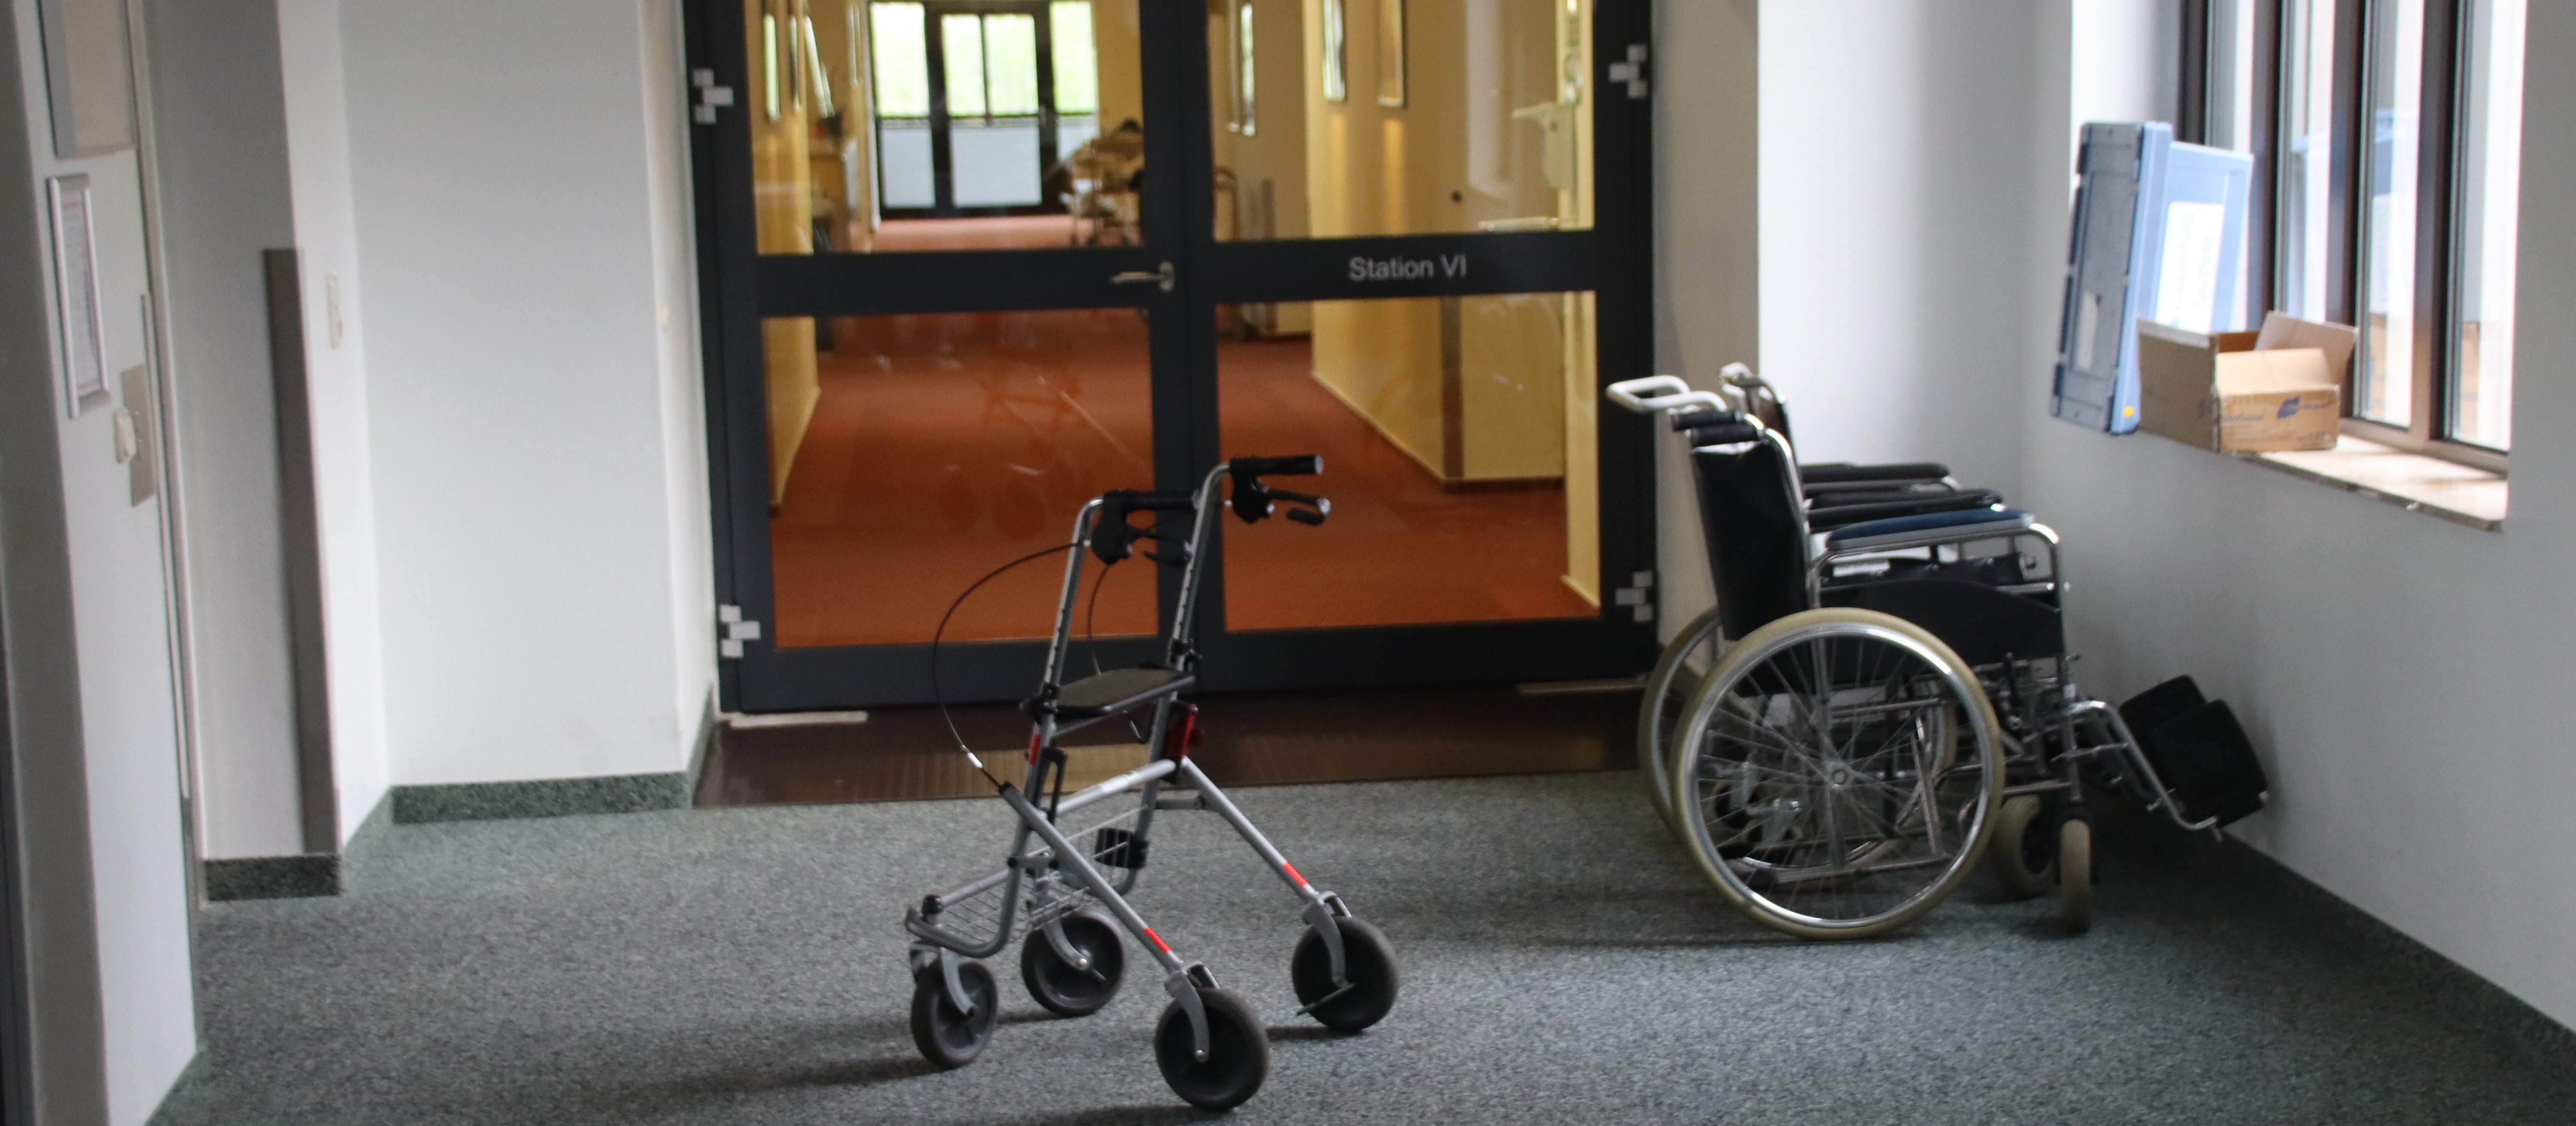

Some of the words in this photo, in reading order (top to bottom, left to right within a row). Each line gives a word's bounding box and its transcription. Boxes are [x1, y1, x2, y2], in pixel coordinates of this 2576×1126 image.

[1349, 256, 1434, 281] Station
[1440, 254, 1466, 278] VI
[2192, 235, 2213, 309] Apotheke
